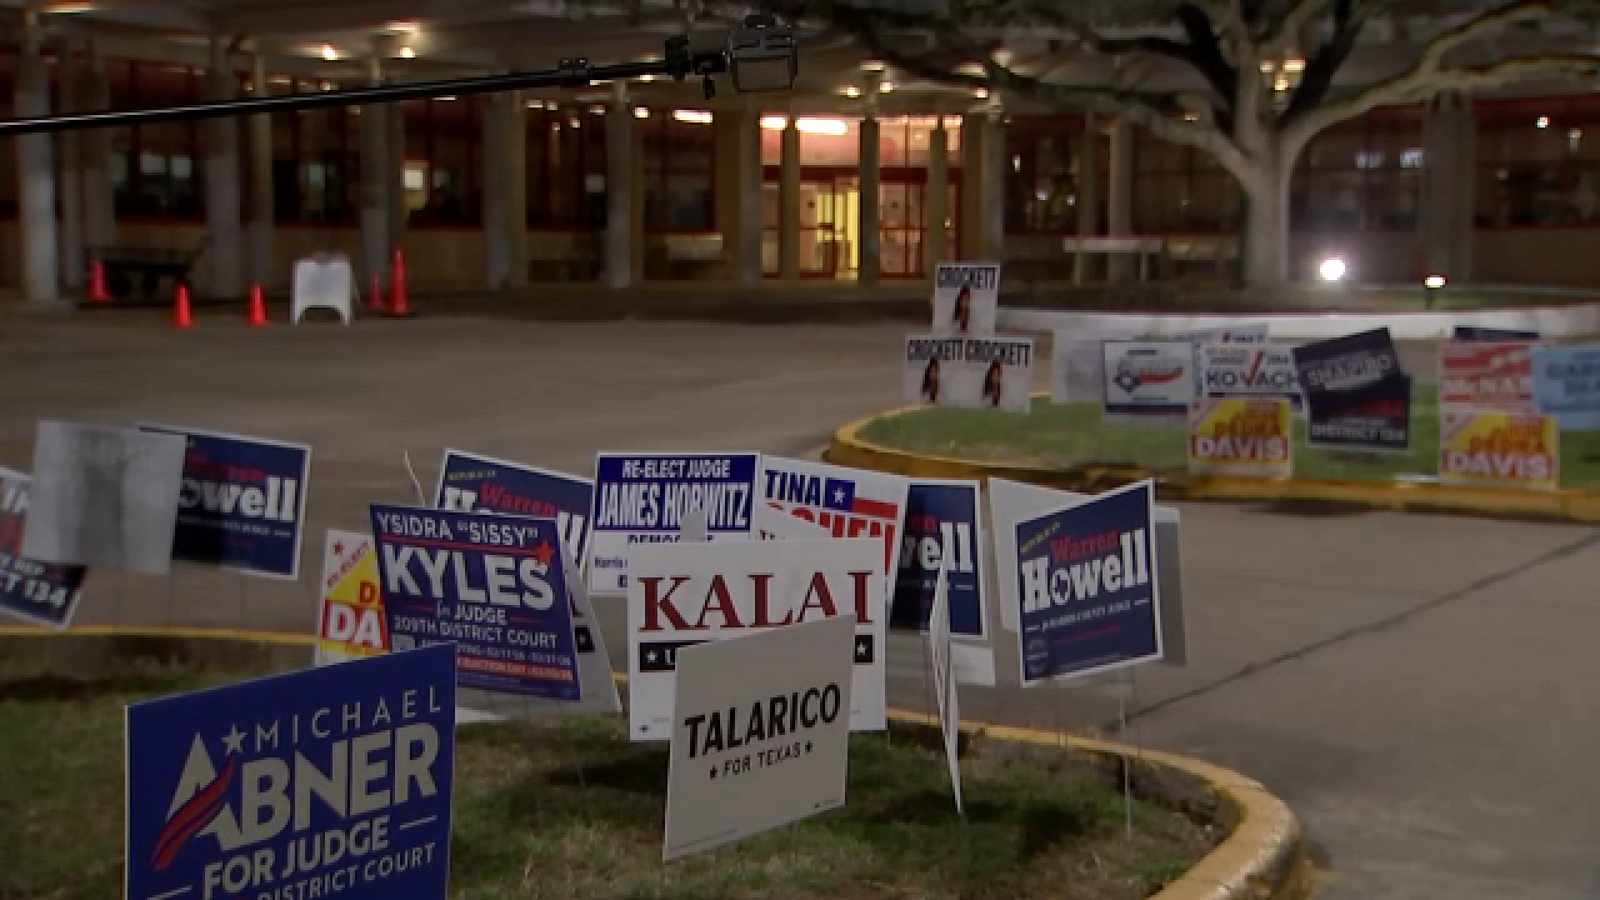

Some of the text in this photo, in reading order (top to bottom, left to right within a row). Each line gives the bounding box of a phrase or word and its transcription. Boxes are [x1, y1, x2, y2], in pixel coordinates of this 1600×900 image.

[938, 266, 996, 290] CROCKETT
[907, 339, 963, 361] CROCKETT
[965, 339, 1031, 368] CROCKETT
[1197, 436, 1285, 460] DAVIS
[1449, 453, 1547, 477] DAVIS
[622, 459, 731, 478] RE-ELECT JUDGE
[178, 476, 297, 521] owell
[599, 482, 750, 529] JAMES HORWITZ
[764, 469, 821, 506] TINA
[377, 511, 453, 539] YSIDRA
[1051, 530, 1121, 564] Warren
[382, 542, 554, 610] KYLES
[1021, 527, 1149, 614] Howell
[454, 604, 508, 626] JUDGE
[637, 570, 874, 632] KALAI
[437, 618, 503, 642] DISTRICT
[507, 629, 559, 650] COURT
[255, 684, 442, 752] MICHAEL
[684, 682, 841, 759] TALARICO
[722, 742, 801, 779] FOR TEXAS
[160, 722, 440, 852] ABNER
[203, 814, 391, 900] FOR JUDGE
[364, 842, 436, 882] COURT
